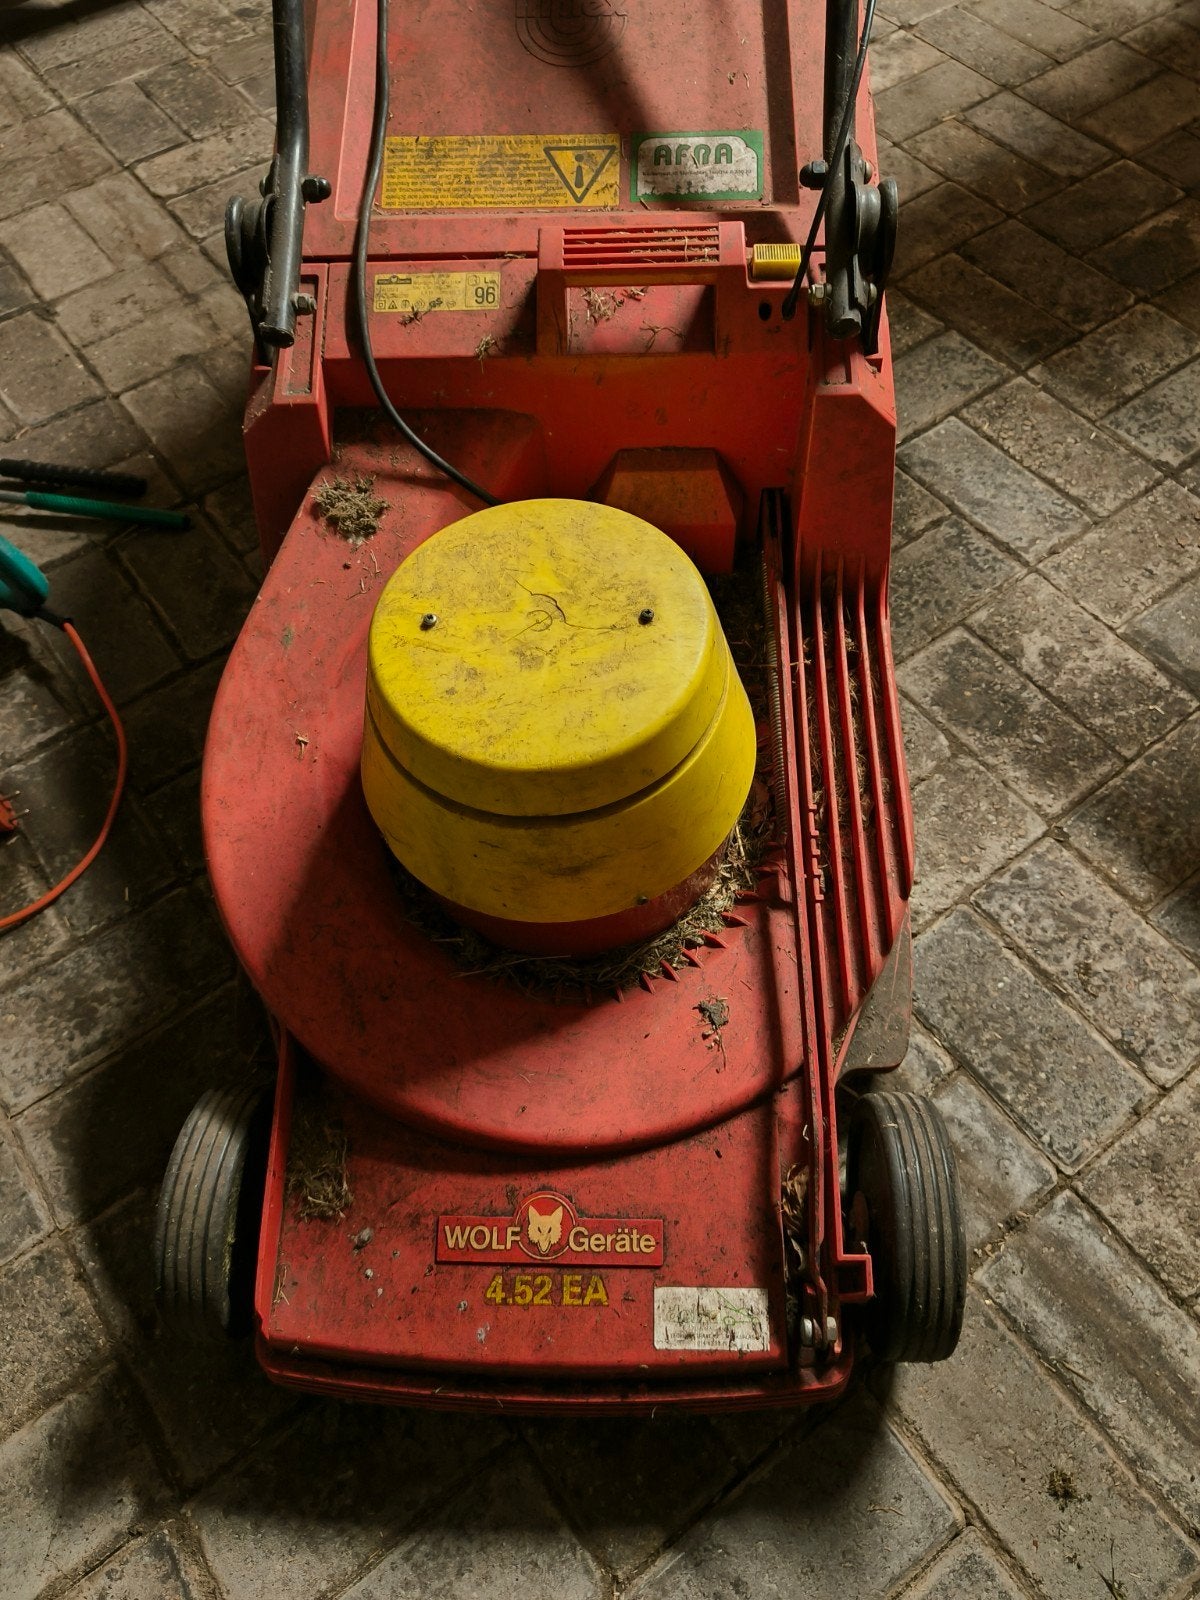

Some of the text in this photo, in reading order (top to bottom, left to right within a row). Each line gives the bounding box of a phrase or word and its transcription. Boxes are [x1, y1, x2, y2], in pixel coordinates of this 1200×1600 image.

[474, 286, 496, 305] 96
[444, 1225, 657, 1254] WOLF Geräte
[484, 1274, 609, 1306] 4.52 EA
